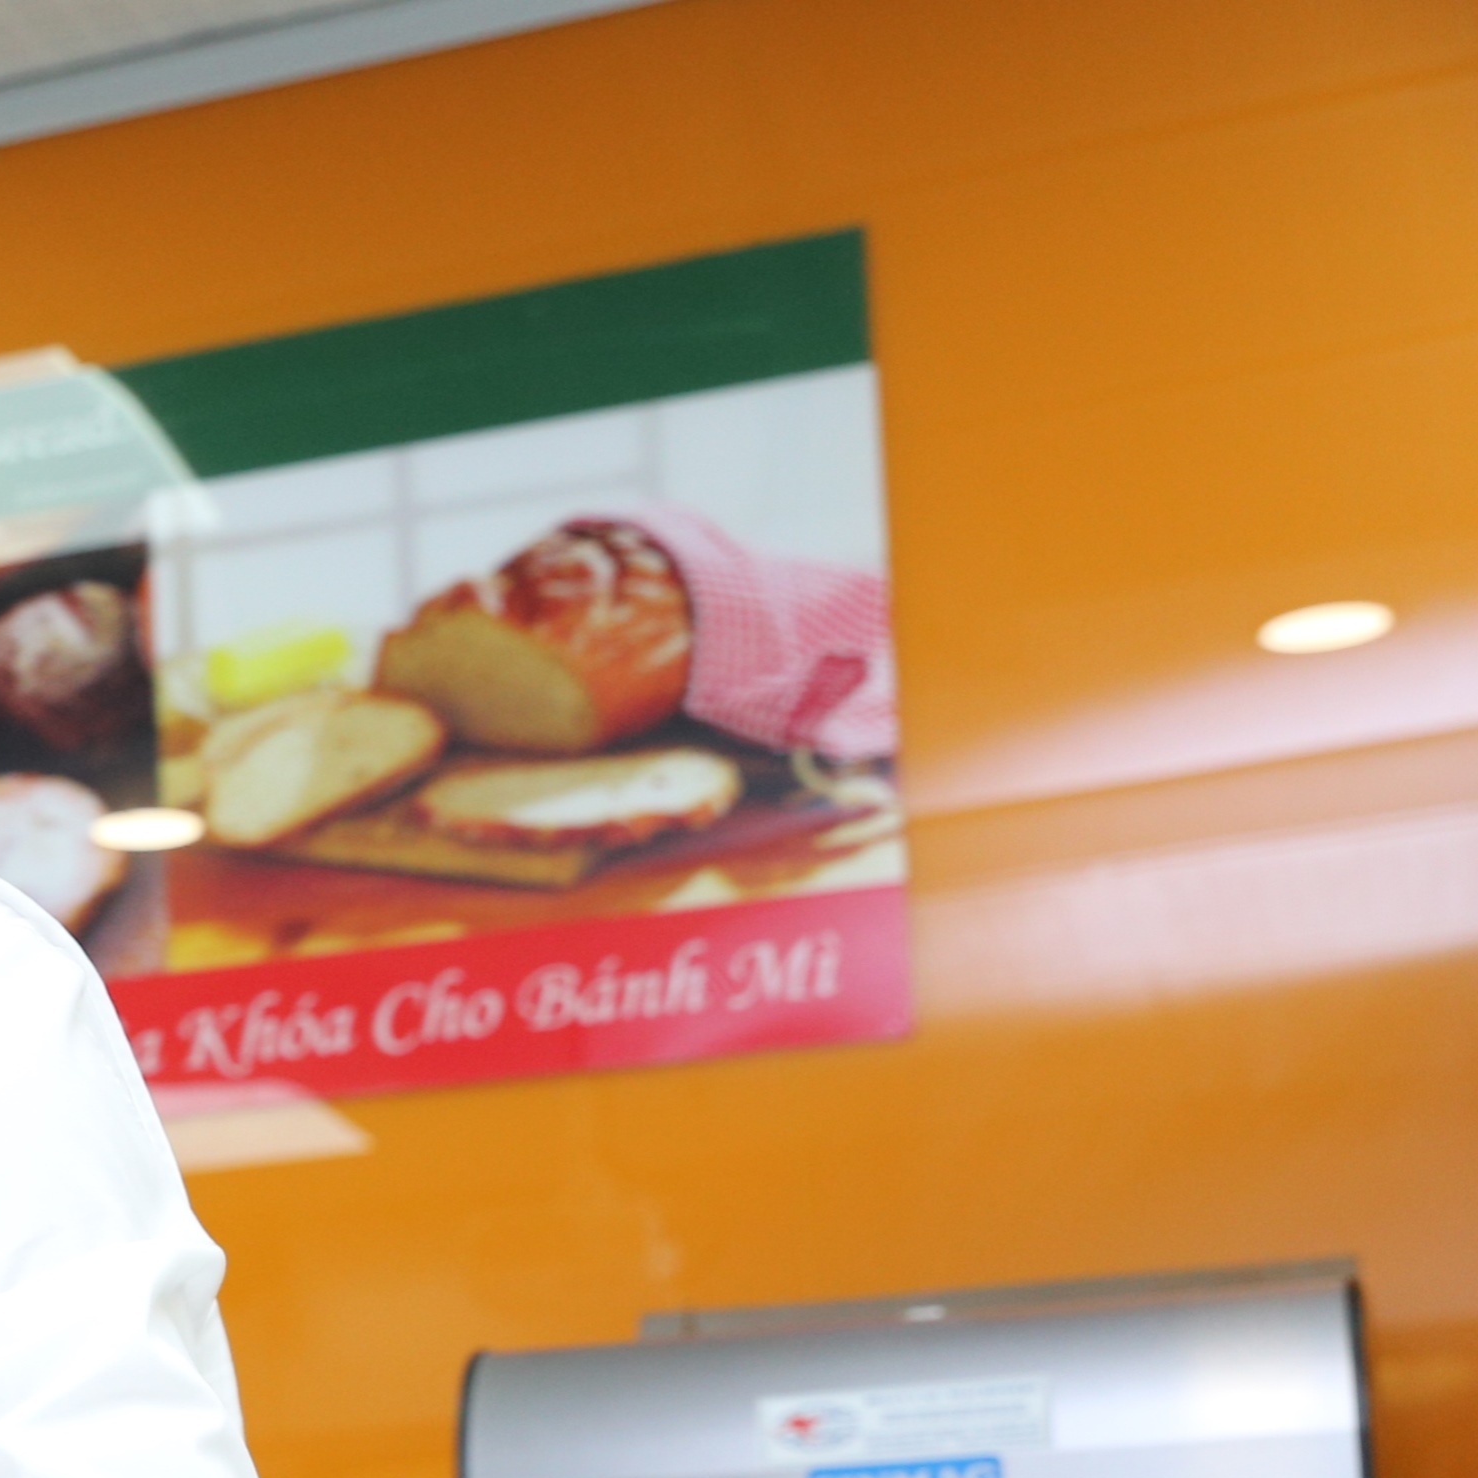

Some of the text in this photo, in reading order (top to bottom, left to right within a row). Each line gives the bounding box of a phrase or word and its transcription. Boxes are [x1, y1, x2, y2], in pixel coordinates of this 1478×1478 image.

[175, 988, 356, 1078] Khóa
[370, 966, 505, 1058] Cho
[513, 935, 710, 1034] Bánh
